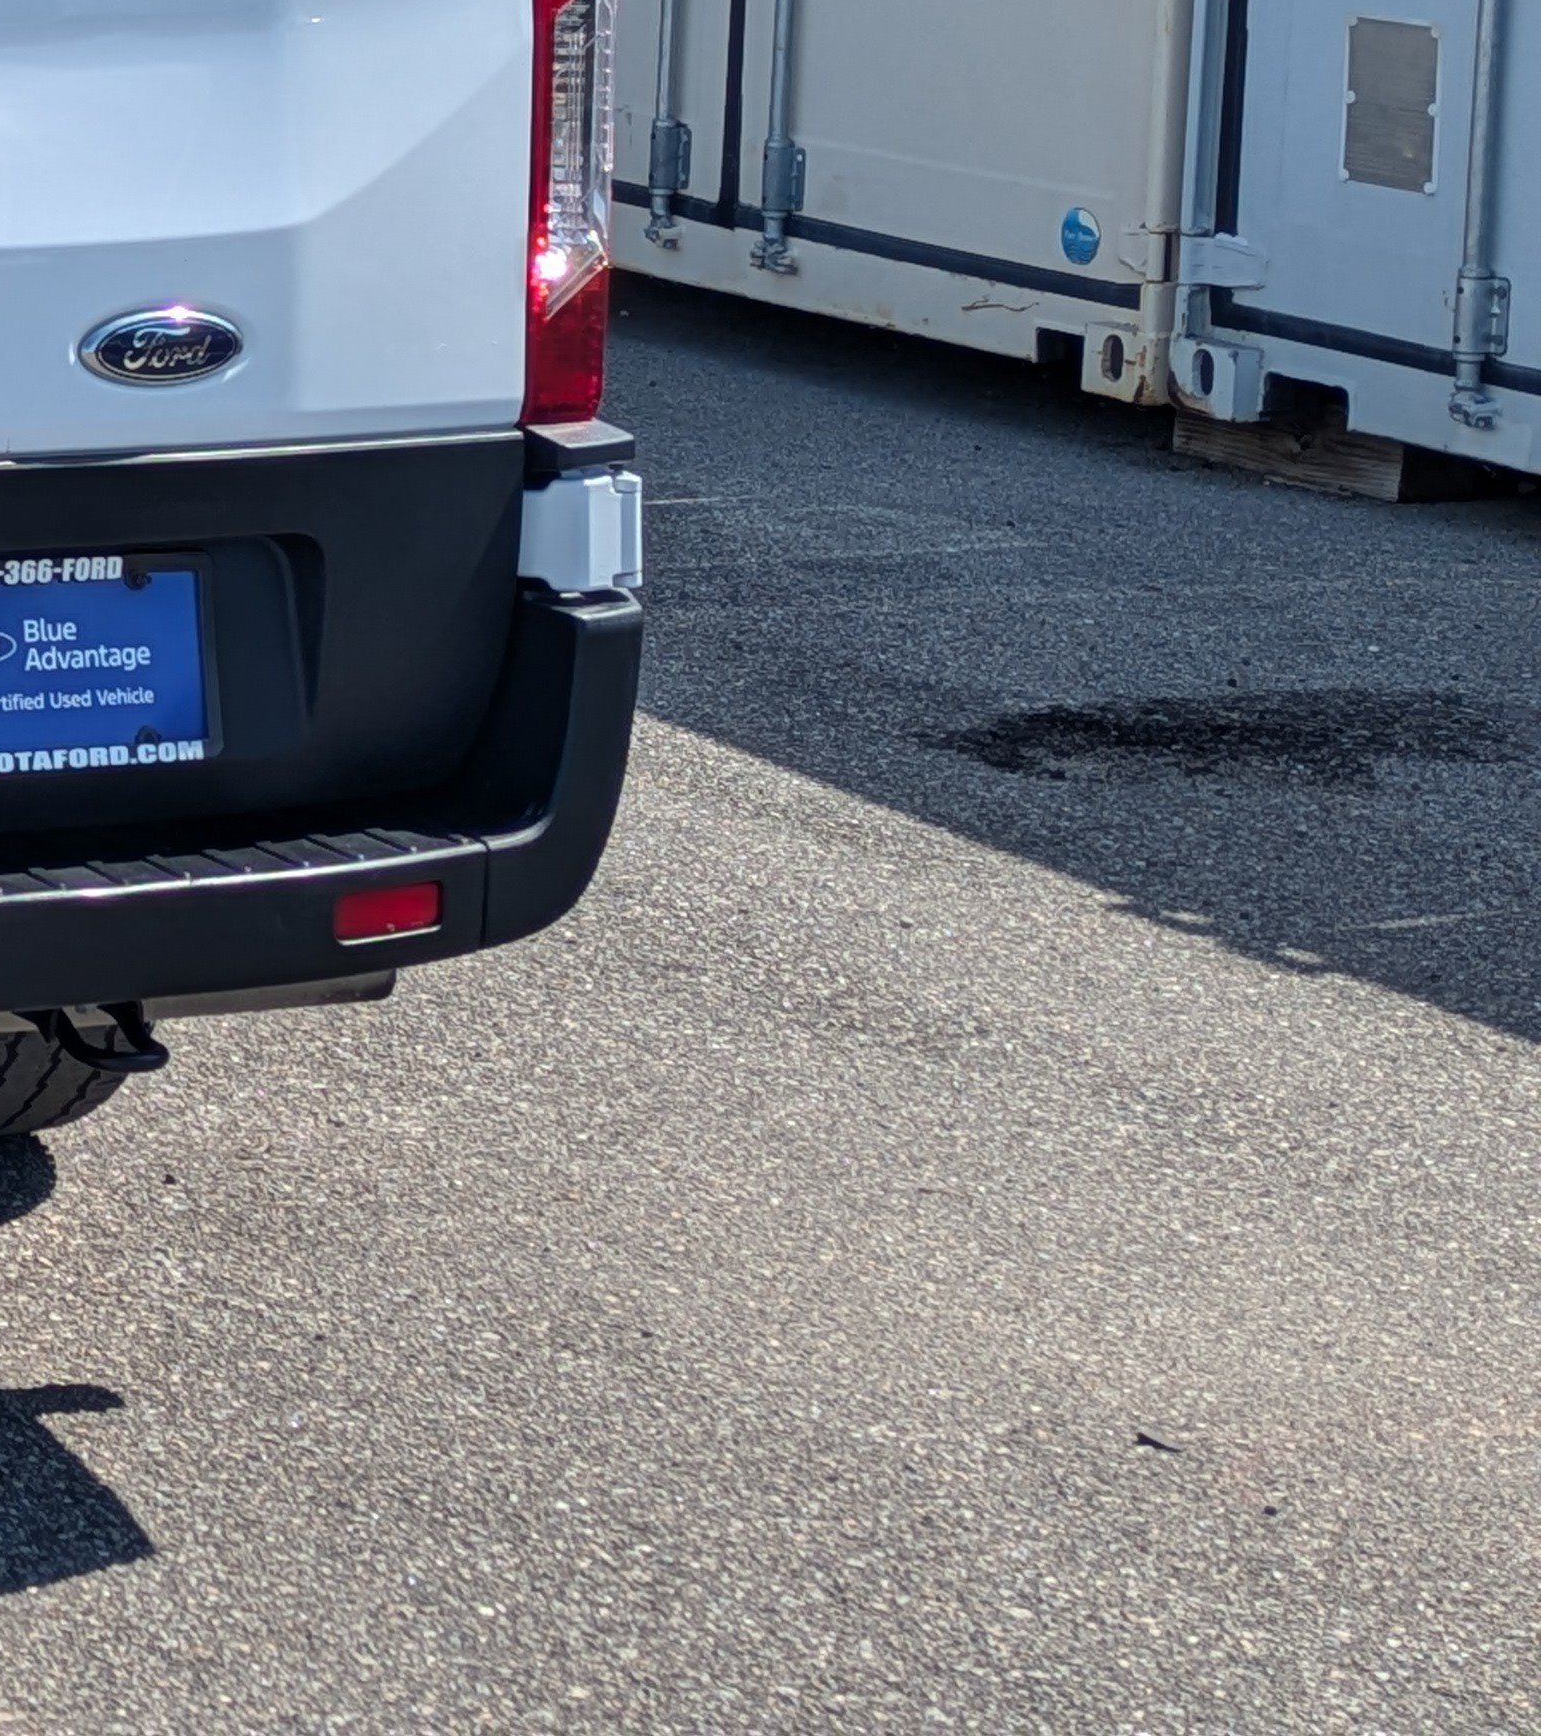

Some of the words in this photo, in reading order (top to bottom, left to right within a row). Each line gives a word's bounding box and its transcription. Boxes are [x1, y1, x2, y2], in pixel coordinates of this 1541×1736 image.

[123, 326, 212, 371] Ford
[23, 618, 77, 643] Blue
[24, 644, 151, 672] Advantage
[49, 691, 92, 708] Used
[97, 687, 155, 706] Vehicle
